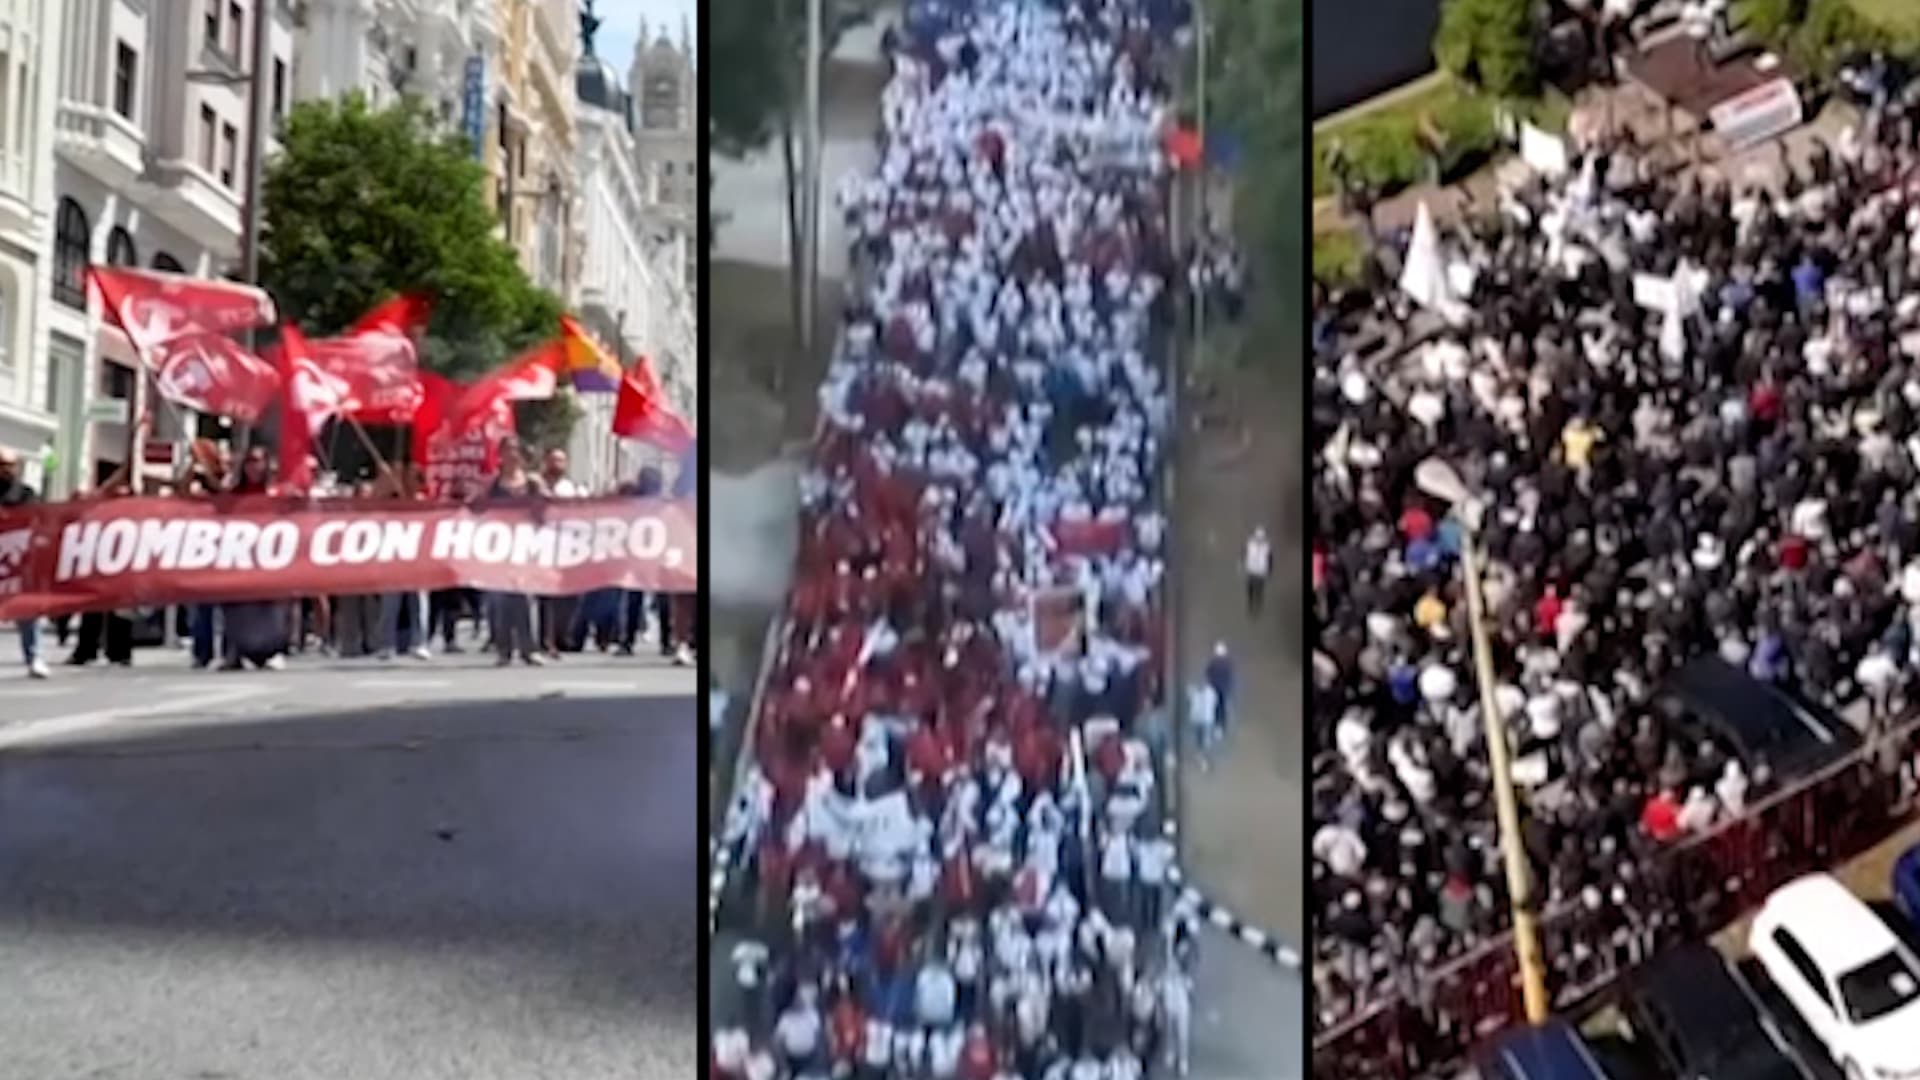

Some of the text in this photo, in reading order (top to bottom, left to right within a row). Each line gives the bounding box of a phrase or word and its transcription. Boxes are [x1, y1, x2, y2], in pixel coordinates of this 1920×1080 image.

[55, 517, 683, 582] HOMBRO CON HOMBRO,
